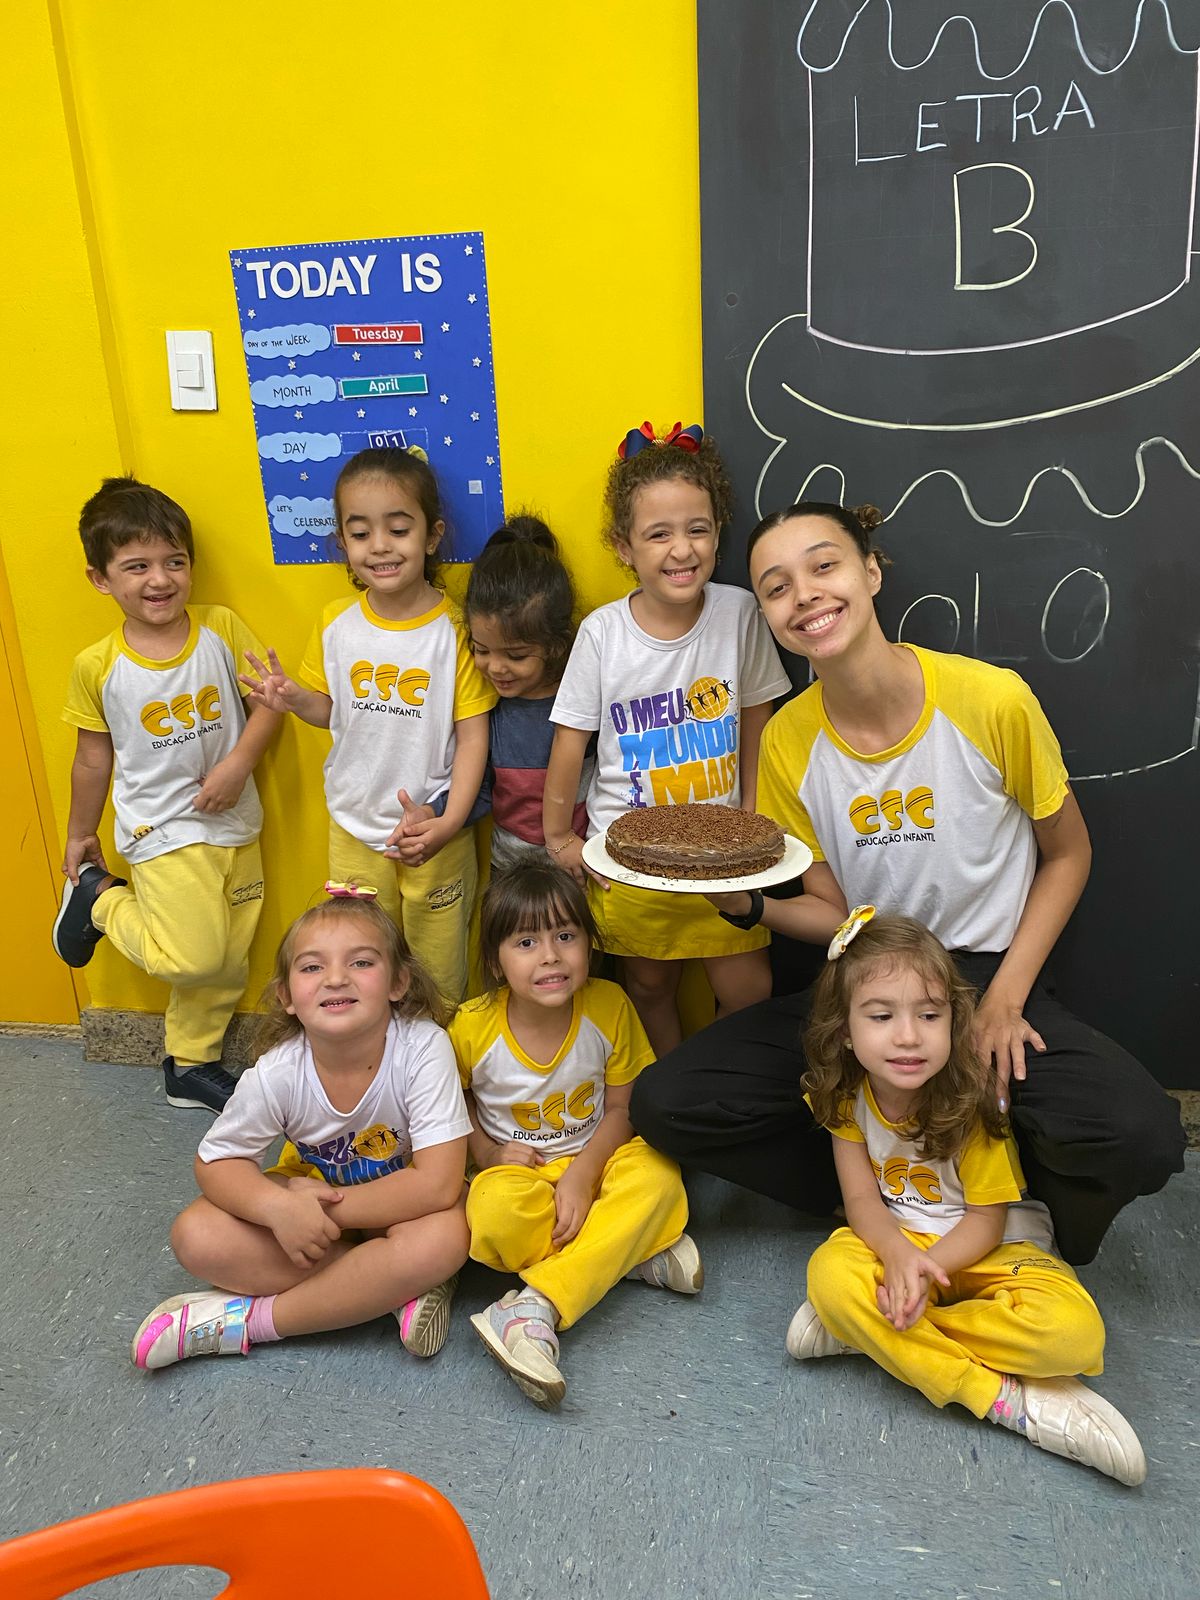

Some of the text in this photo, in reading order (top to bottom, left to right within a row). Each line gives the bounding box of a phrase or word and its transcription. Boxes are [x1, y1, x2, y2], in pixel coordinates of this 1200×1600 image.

[855, 81, 1095, 166] LETRA
[954, 162, 1038, 290] B
[246, 252, 443, 299] TODAY IS
[261, 340, 268, 348] OF
[286, 334, 311, 345] WEEK
[352, 328, 404, 341] Tuesday
[273, 385, 312, 400] MONTH
[369, 379, 400, 393] April
[283, 442, 307, 454] DAY
[276, 505, 293, 513] LET'S
[293, 517, 336, 528] CELEBRATE
[898, 567, 1110, 664] OLO
[350, 660, 431, 706] CSC
[140, 685, 222, 737] CSC
[351, 701, 422, 718] UCAÇÃO INFANTIL
[610, 687, 686, 735] O MEU
[152, 732, 196, 750] EDUCAÇÃO
[618, 715, 737, 772] MUNDO
[650, 753, 737, 807] MAIS
[849, 786, 935, 835] CSC
[855, 832, 936, 848] EDUCAÇÃO INFANTIL
[511, 1081, 595, 1131] CSC
[513, 1116, 596, 1143] EDUCAÇÃO INFANTIL
